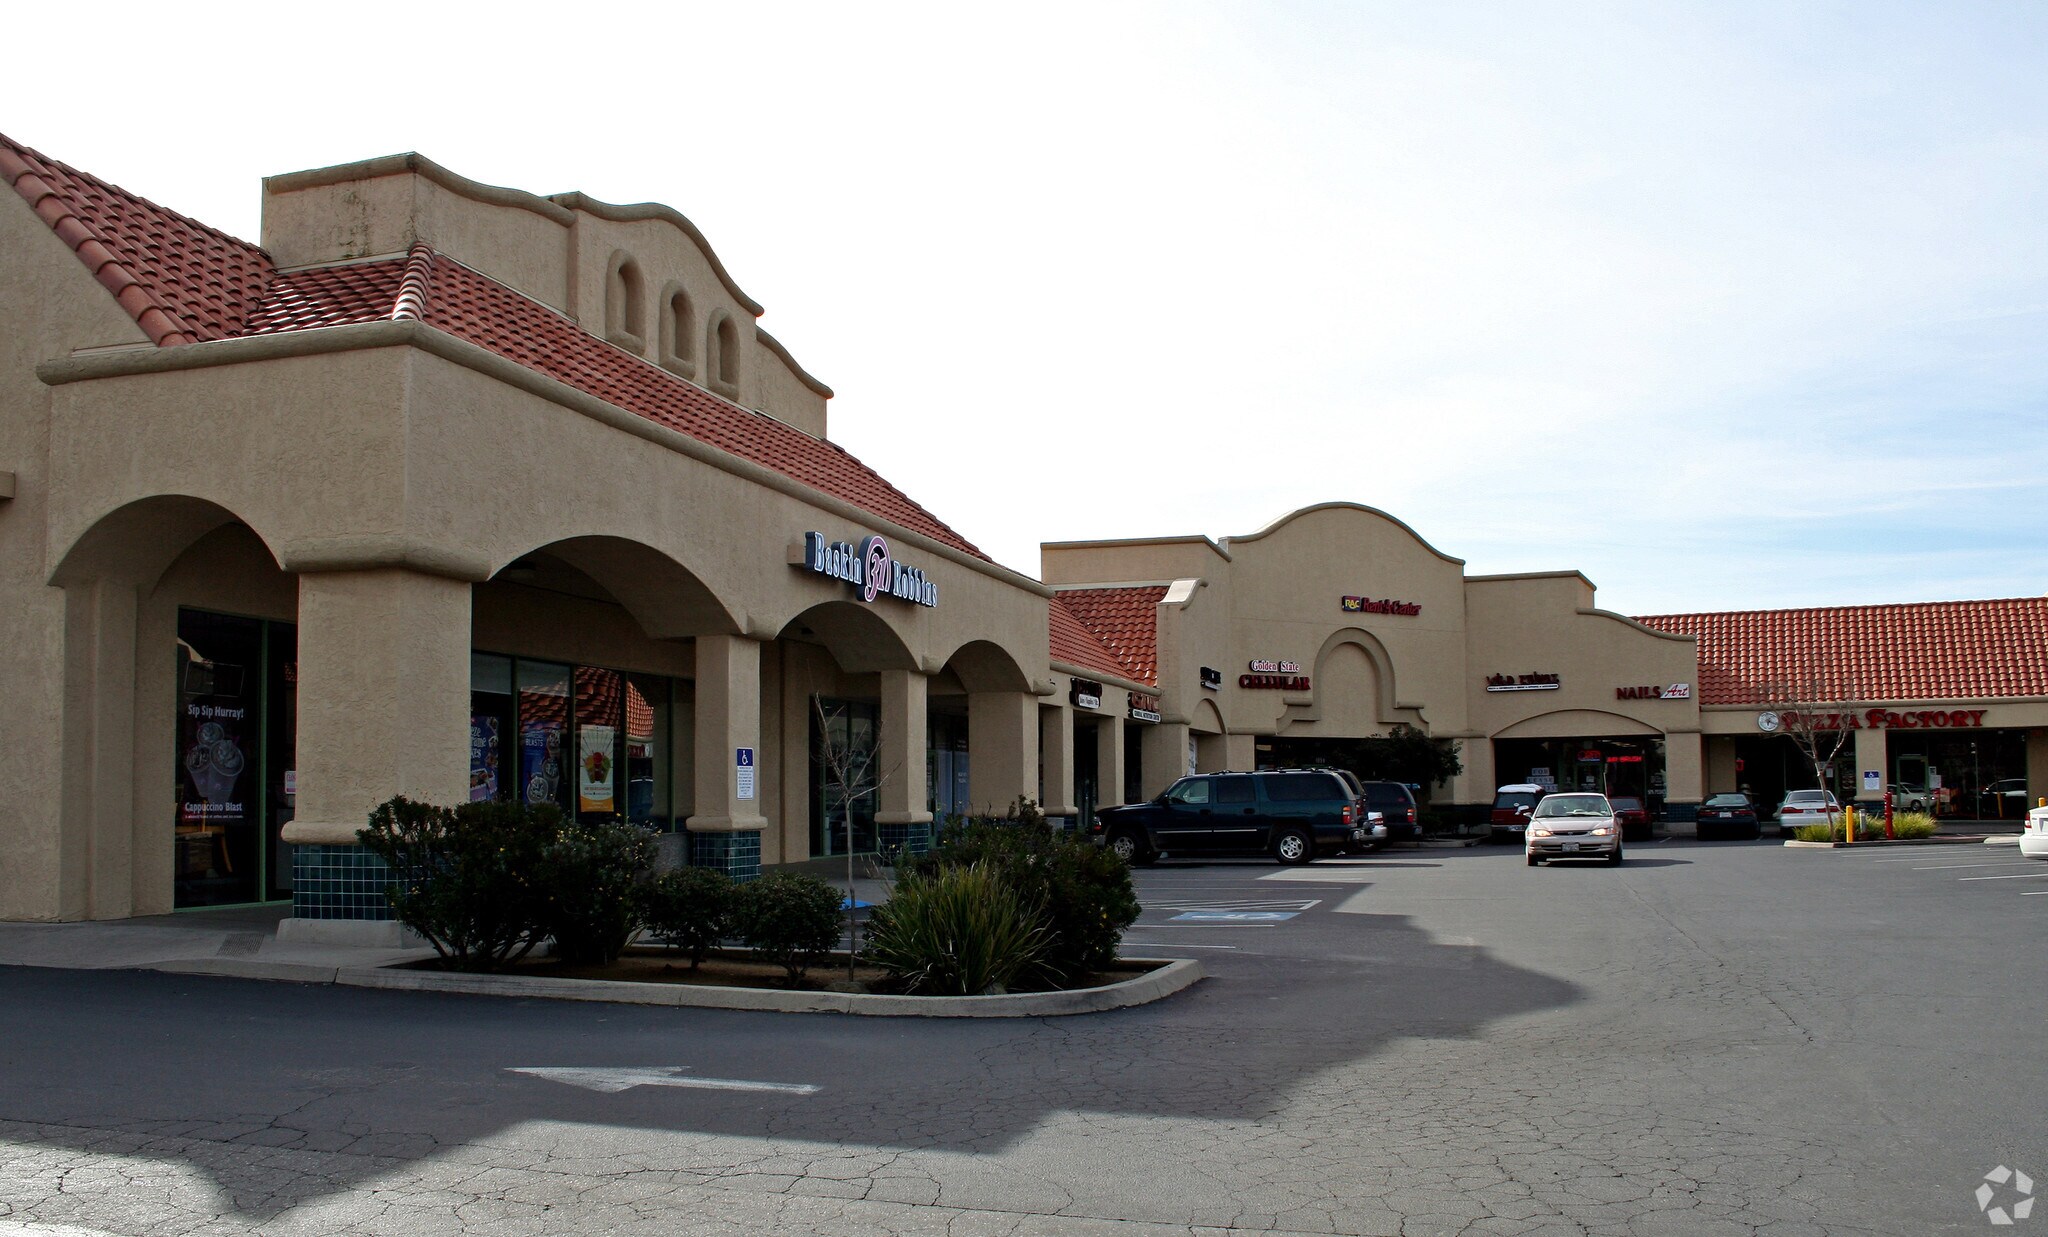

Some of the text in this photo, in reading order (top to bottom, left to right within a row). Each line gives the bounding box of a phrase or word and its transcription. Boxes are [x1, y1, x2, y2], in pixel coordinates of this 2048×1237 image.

[814, 532, 862, 585] Baskin
[893, 560, 937, 607] Robbins
[1345, 599, 1360, 609] RAC
[1250, 660, 1300, 673] Golden State
[1616, 684, 1688, 700] NAILS Art
[187, 704, 244, 720] Sip Sip Hurray!
[1781, 709, 1988, 730] PIZZA FACTORY
[525, 738, 543, 747] BLASTS
[184, 802, 243, 813] Cappuccino Blast
